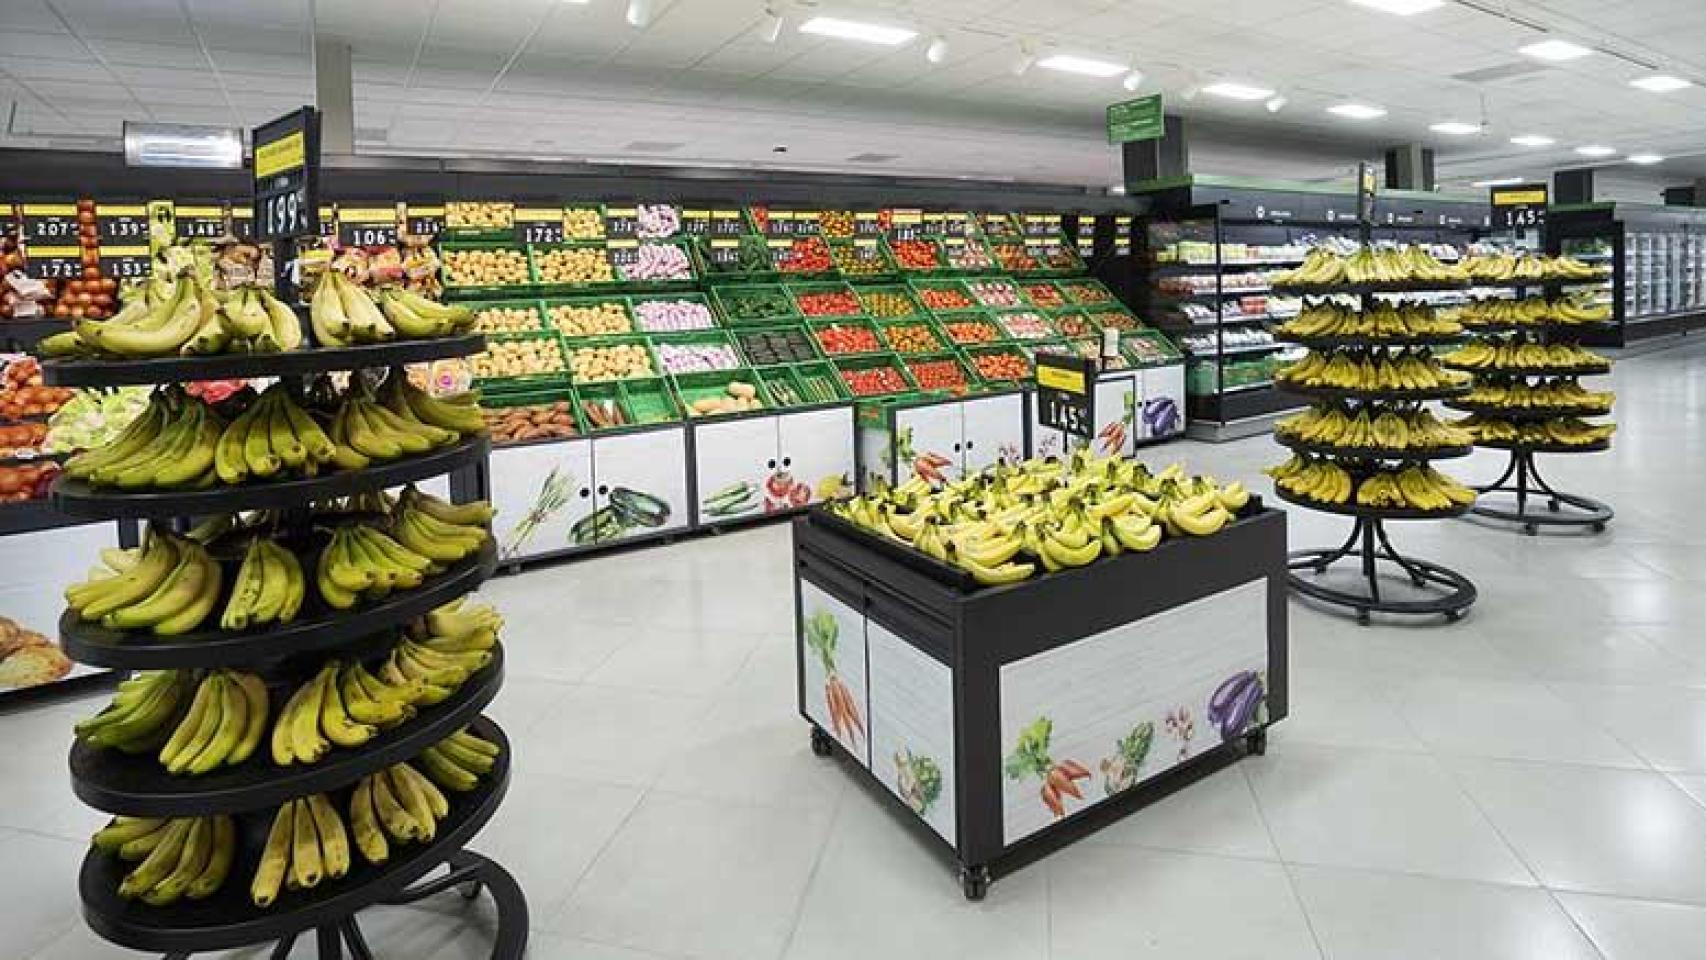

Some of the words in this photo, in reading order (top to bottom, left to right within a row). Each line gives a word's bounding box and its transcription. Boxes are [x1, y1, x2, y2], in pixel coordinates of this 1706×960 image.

[267, 193, 297, 234] 199
[1507, 210, 1535, 225] 145
[37, 223, 68, 236] 207
[109, 223, 139, 236] 139
[353, 230, 385, 245] 106
